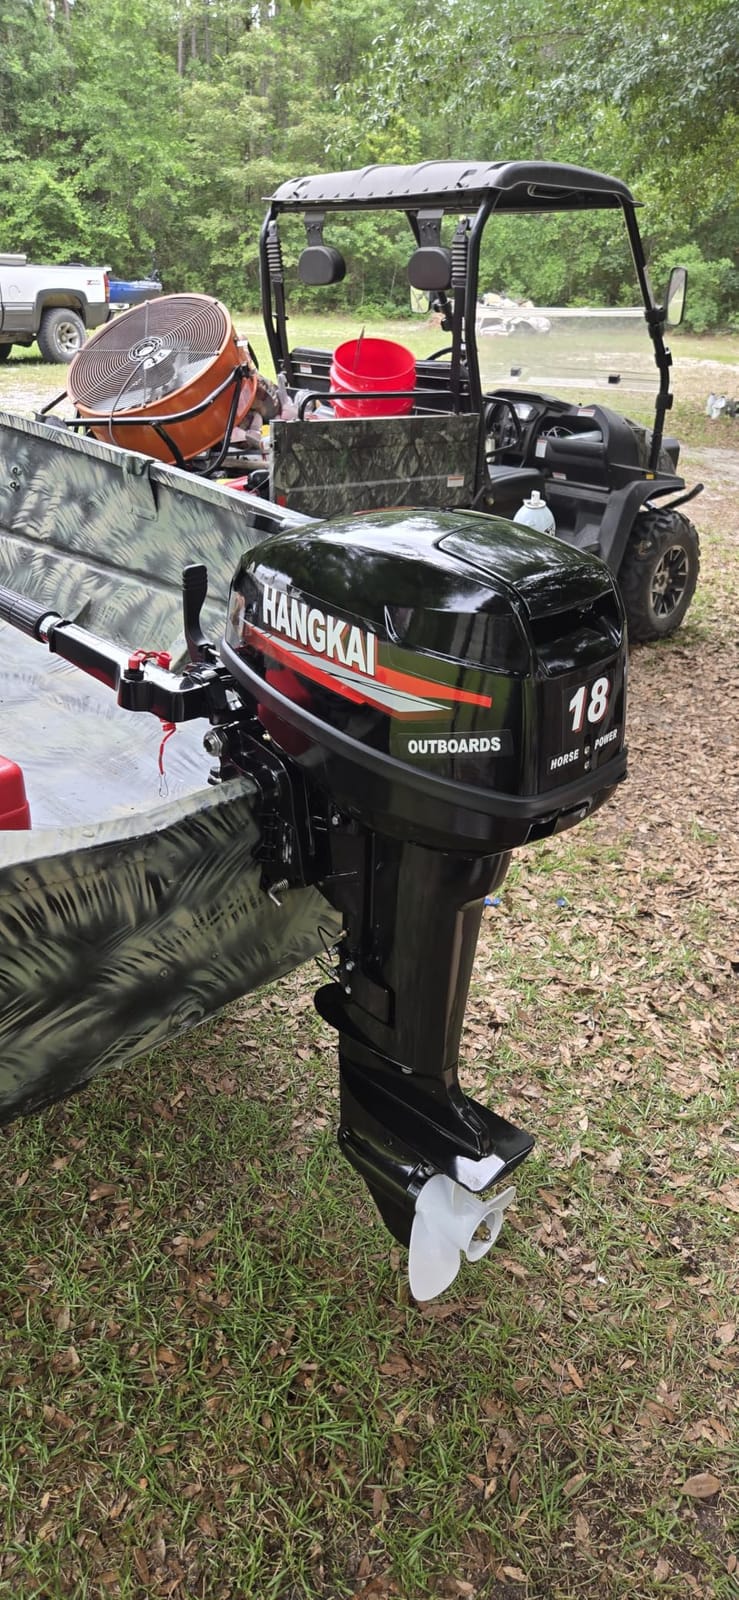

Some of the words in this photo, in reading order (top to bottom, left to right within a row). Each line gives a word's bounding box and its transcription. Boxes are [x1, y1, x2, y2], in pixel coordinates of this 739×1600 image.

[262, 584, 377, 676] HANGKAI
[568, 677, 609, 732] 18
[407, 736, 501, 754] OUTBOARDS
[550, 748, 580, 770] HORSE
[594, 728, 618, 750] POWER
